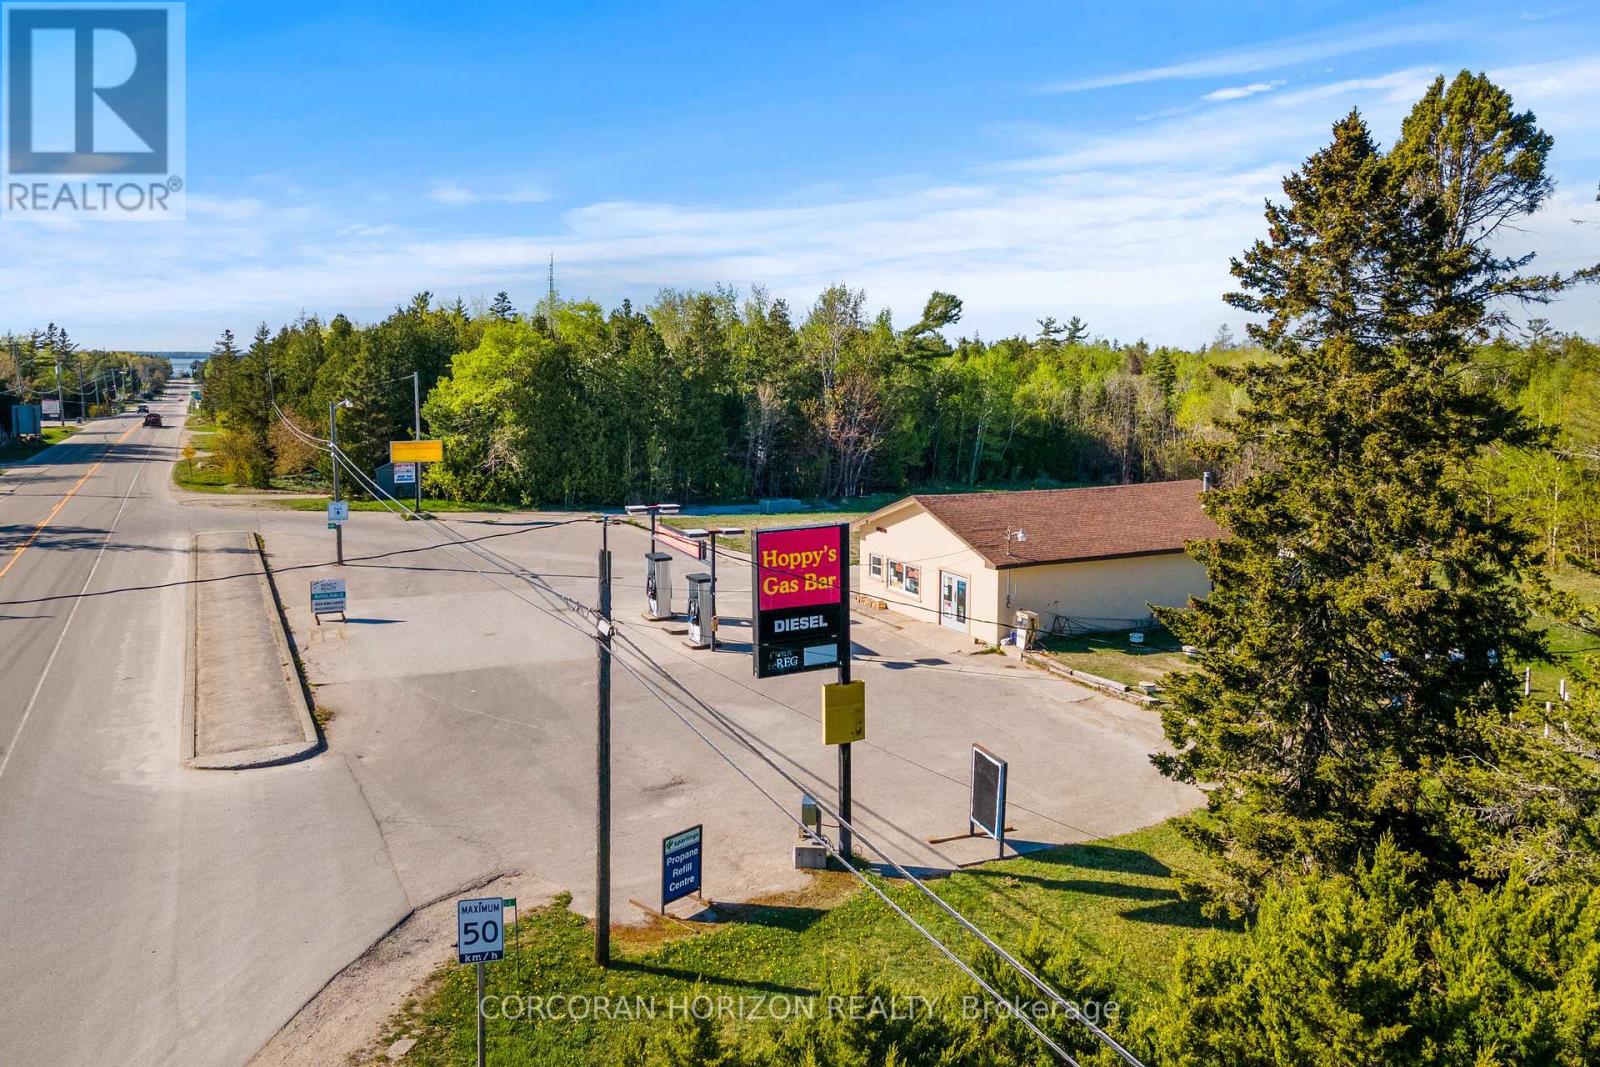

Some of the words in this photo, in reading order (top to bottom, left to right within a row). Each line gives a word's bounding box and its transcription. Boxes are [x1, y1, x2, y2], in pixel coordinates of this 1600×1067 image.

[762, 545, 837, 569] Hoppy's
[763, 576, 799, 596] Gas
[804, 573, 837, 592] Bar
[774, 615, 828, 633] DIESEL
[776, 655, 799, 668] REG
[666, 847, 699, 867] Propane
[672, 861, 693, 878] Refill
[669, 875, 695, 892] Centre
[461, 902, 500, 914] MAXIMUM
[463, 920, 499, 945] 50
[464, 952, 498, 962] km/h
